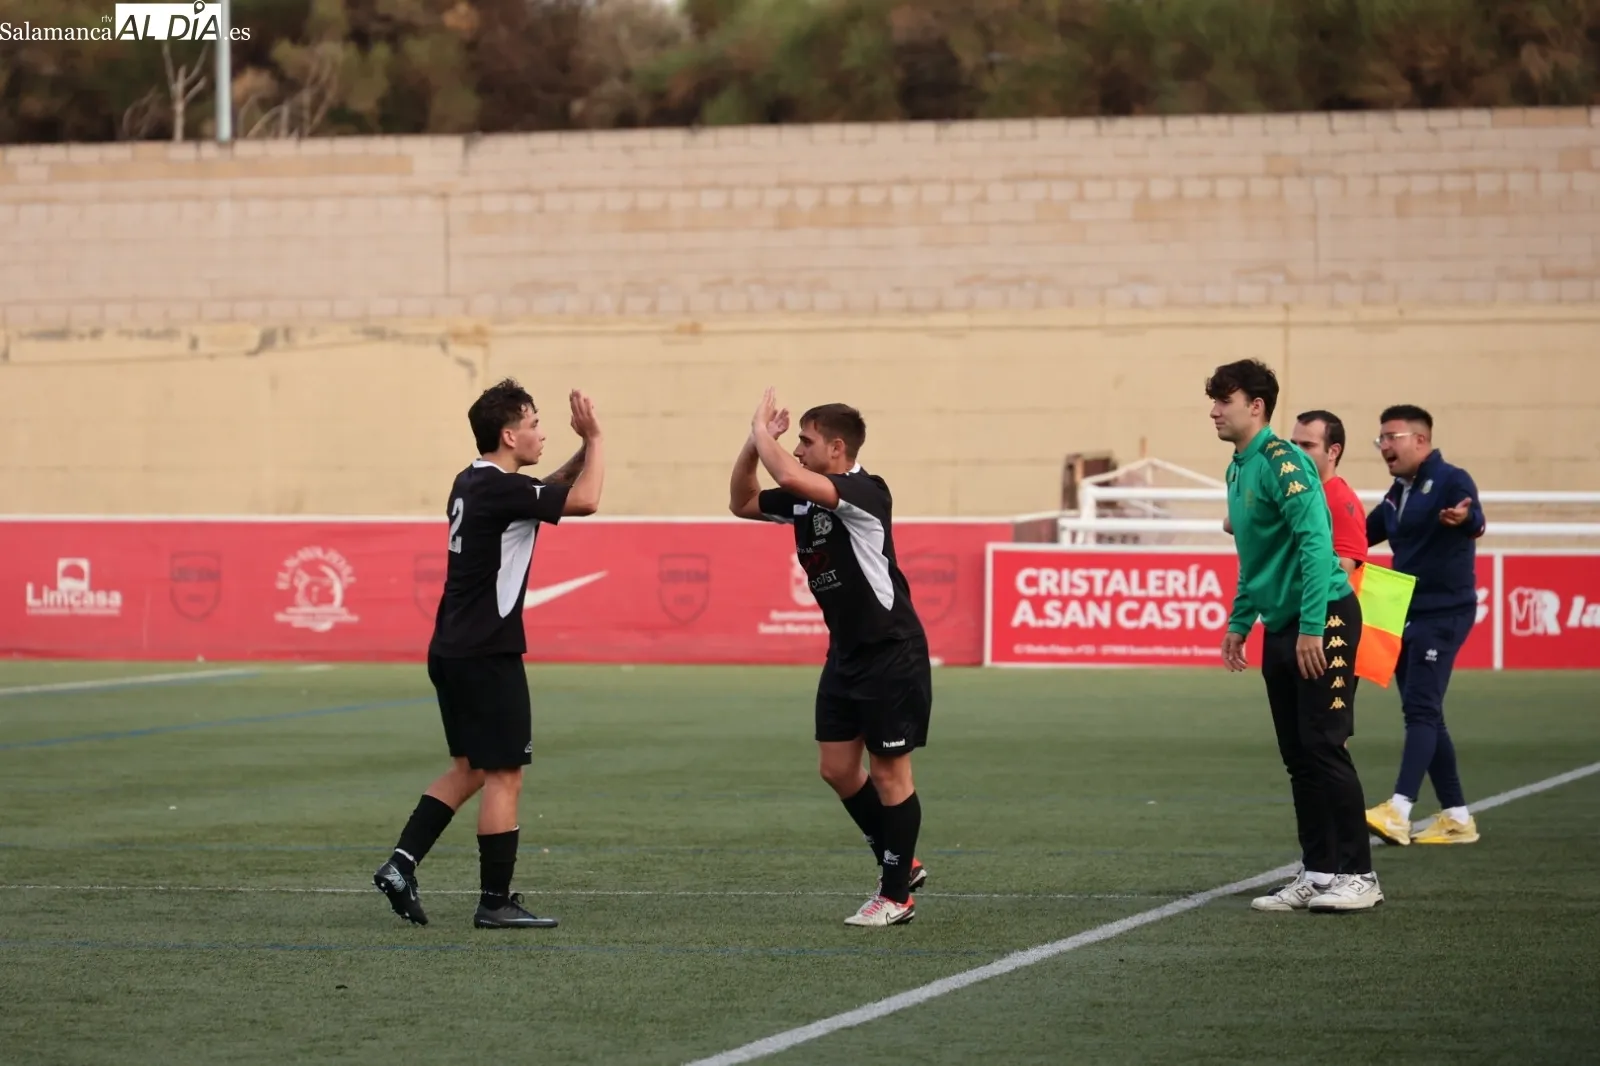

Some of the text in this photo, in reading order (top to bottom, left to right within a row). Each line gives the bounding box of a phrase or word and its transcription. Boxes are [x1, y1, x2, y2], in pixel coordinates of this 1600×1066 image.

[448, 497, 464, 554] 2
[26, 582, 122, 608] Limcasa
[1015, 564, 1223, 599] CRISTALERÍA
[1011, 599, 1227, 631] A.SAN CASTO
